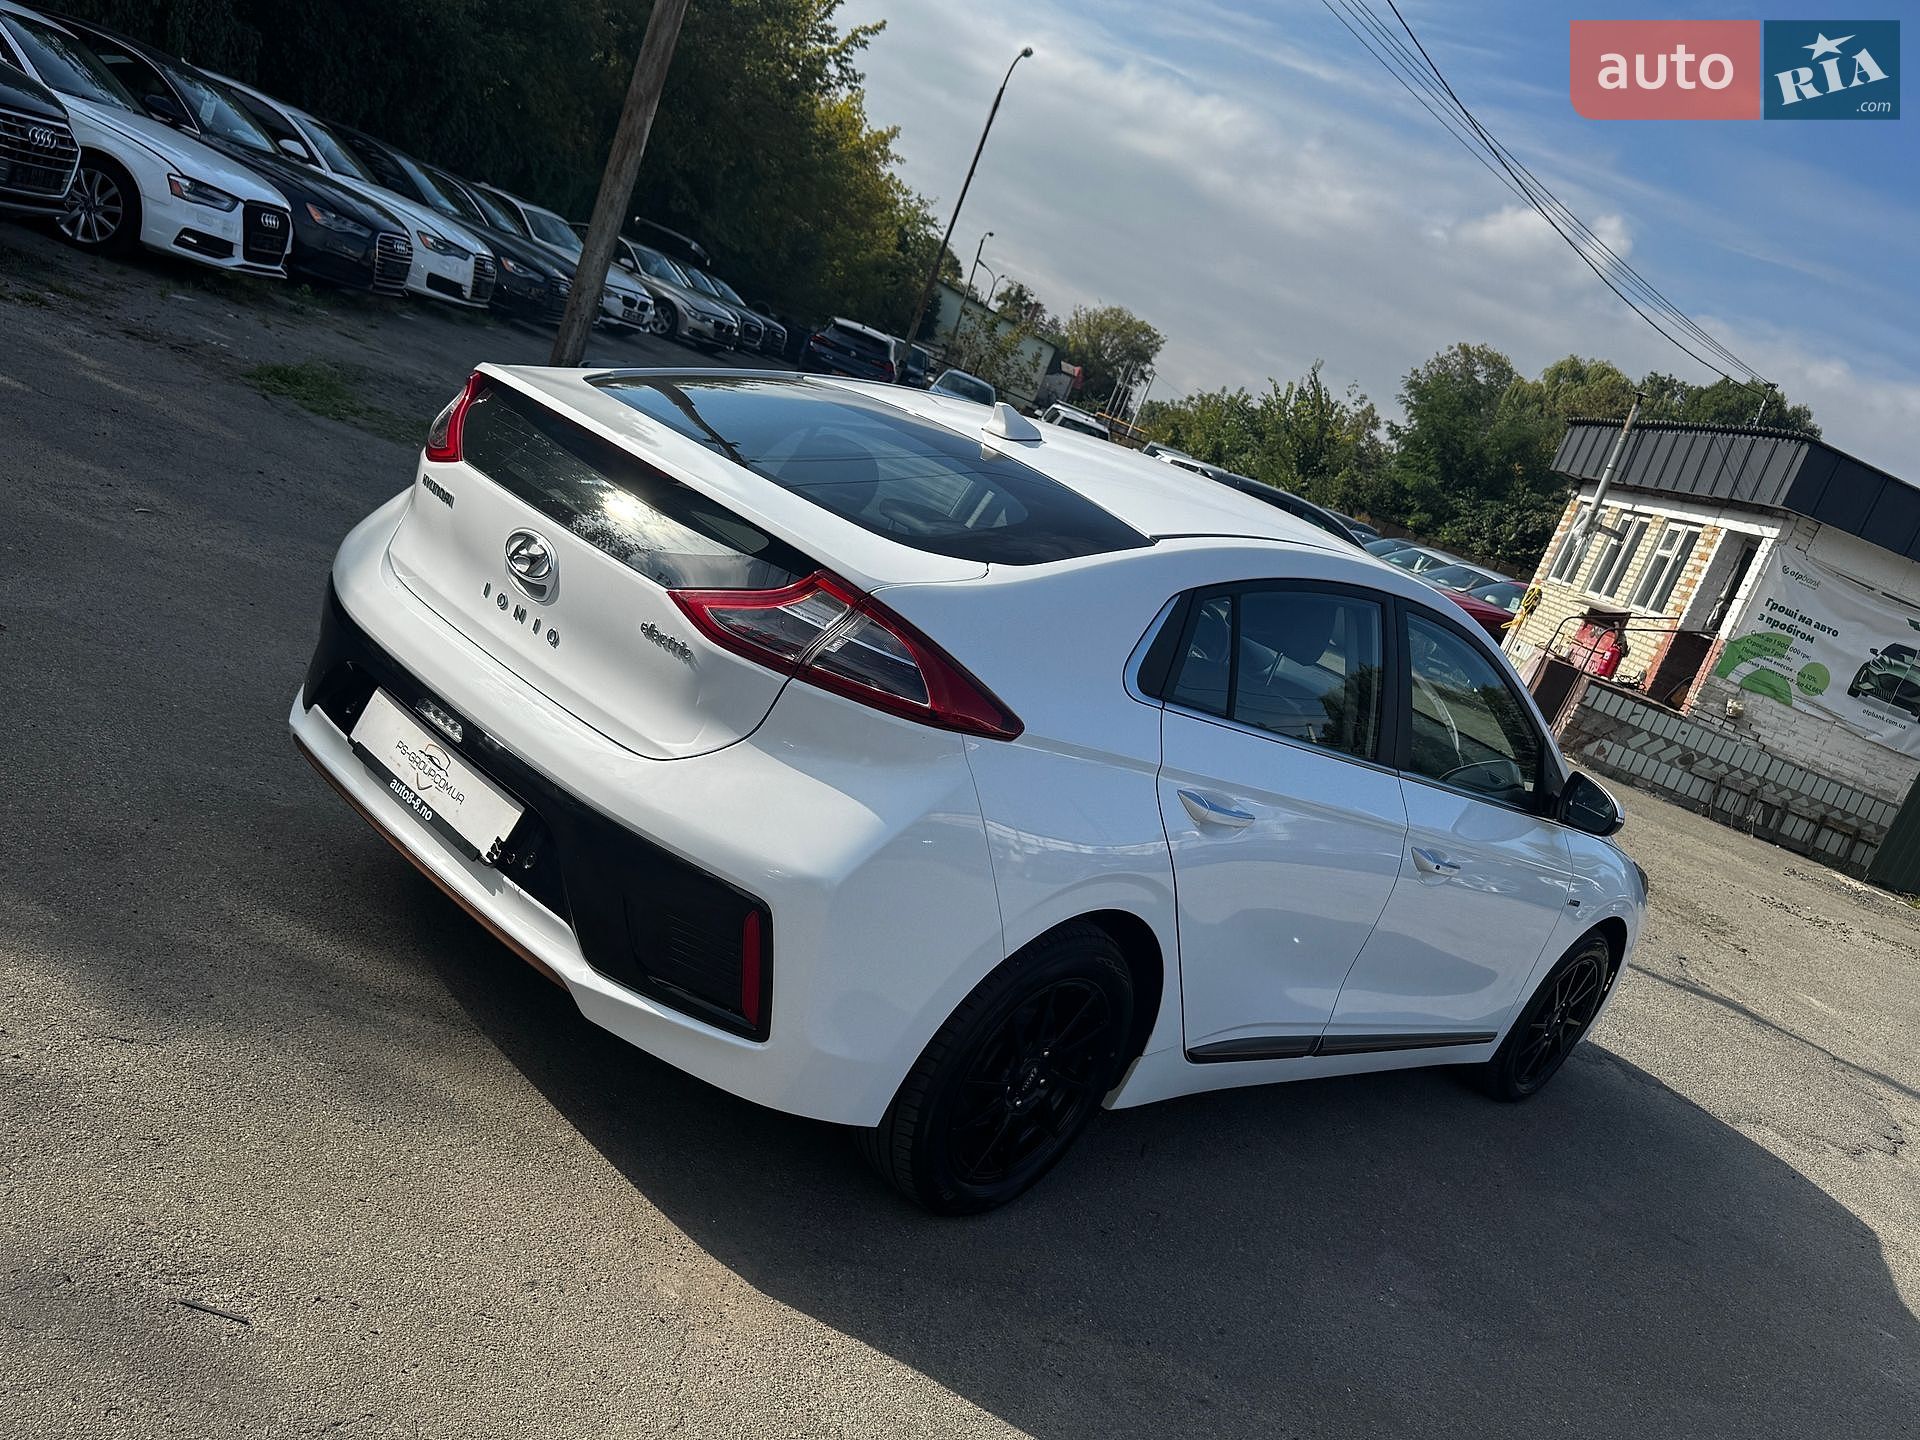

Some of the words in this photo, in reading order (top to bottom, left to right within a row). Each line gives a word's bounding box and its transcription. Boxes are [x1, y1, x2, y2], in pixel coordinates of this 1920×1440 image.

[482, 581, 560, 649] IONIQ
[1757, 613, 1765, 622] з
[1765, 616, 1815, 644] пробігом
[1764, 597, 1800, 620] Гроші
[1797, 614, 1813, 627] на
[1813, 621, 1839, 637] авто
[640, 621, 694, 662] electric
[389, 779, 433, 821] auto8-8.no
